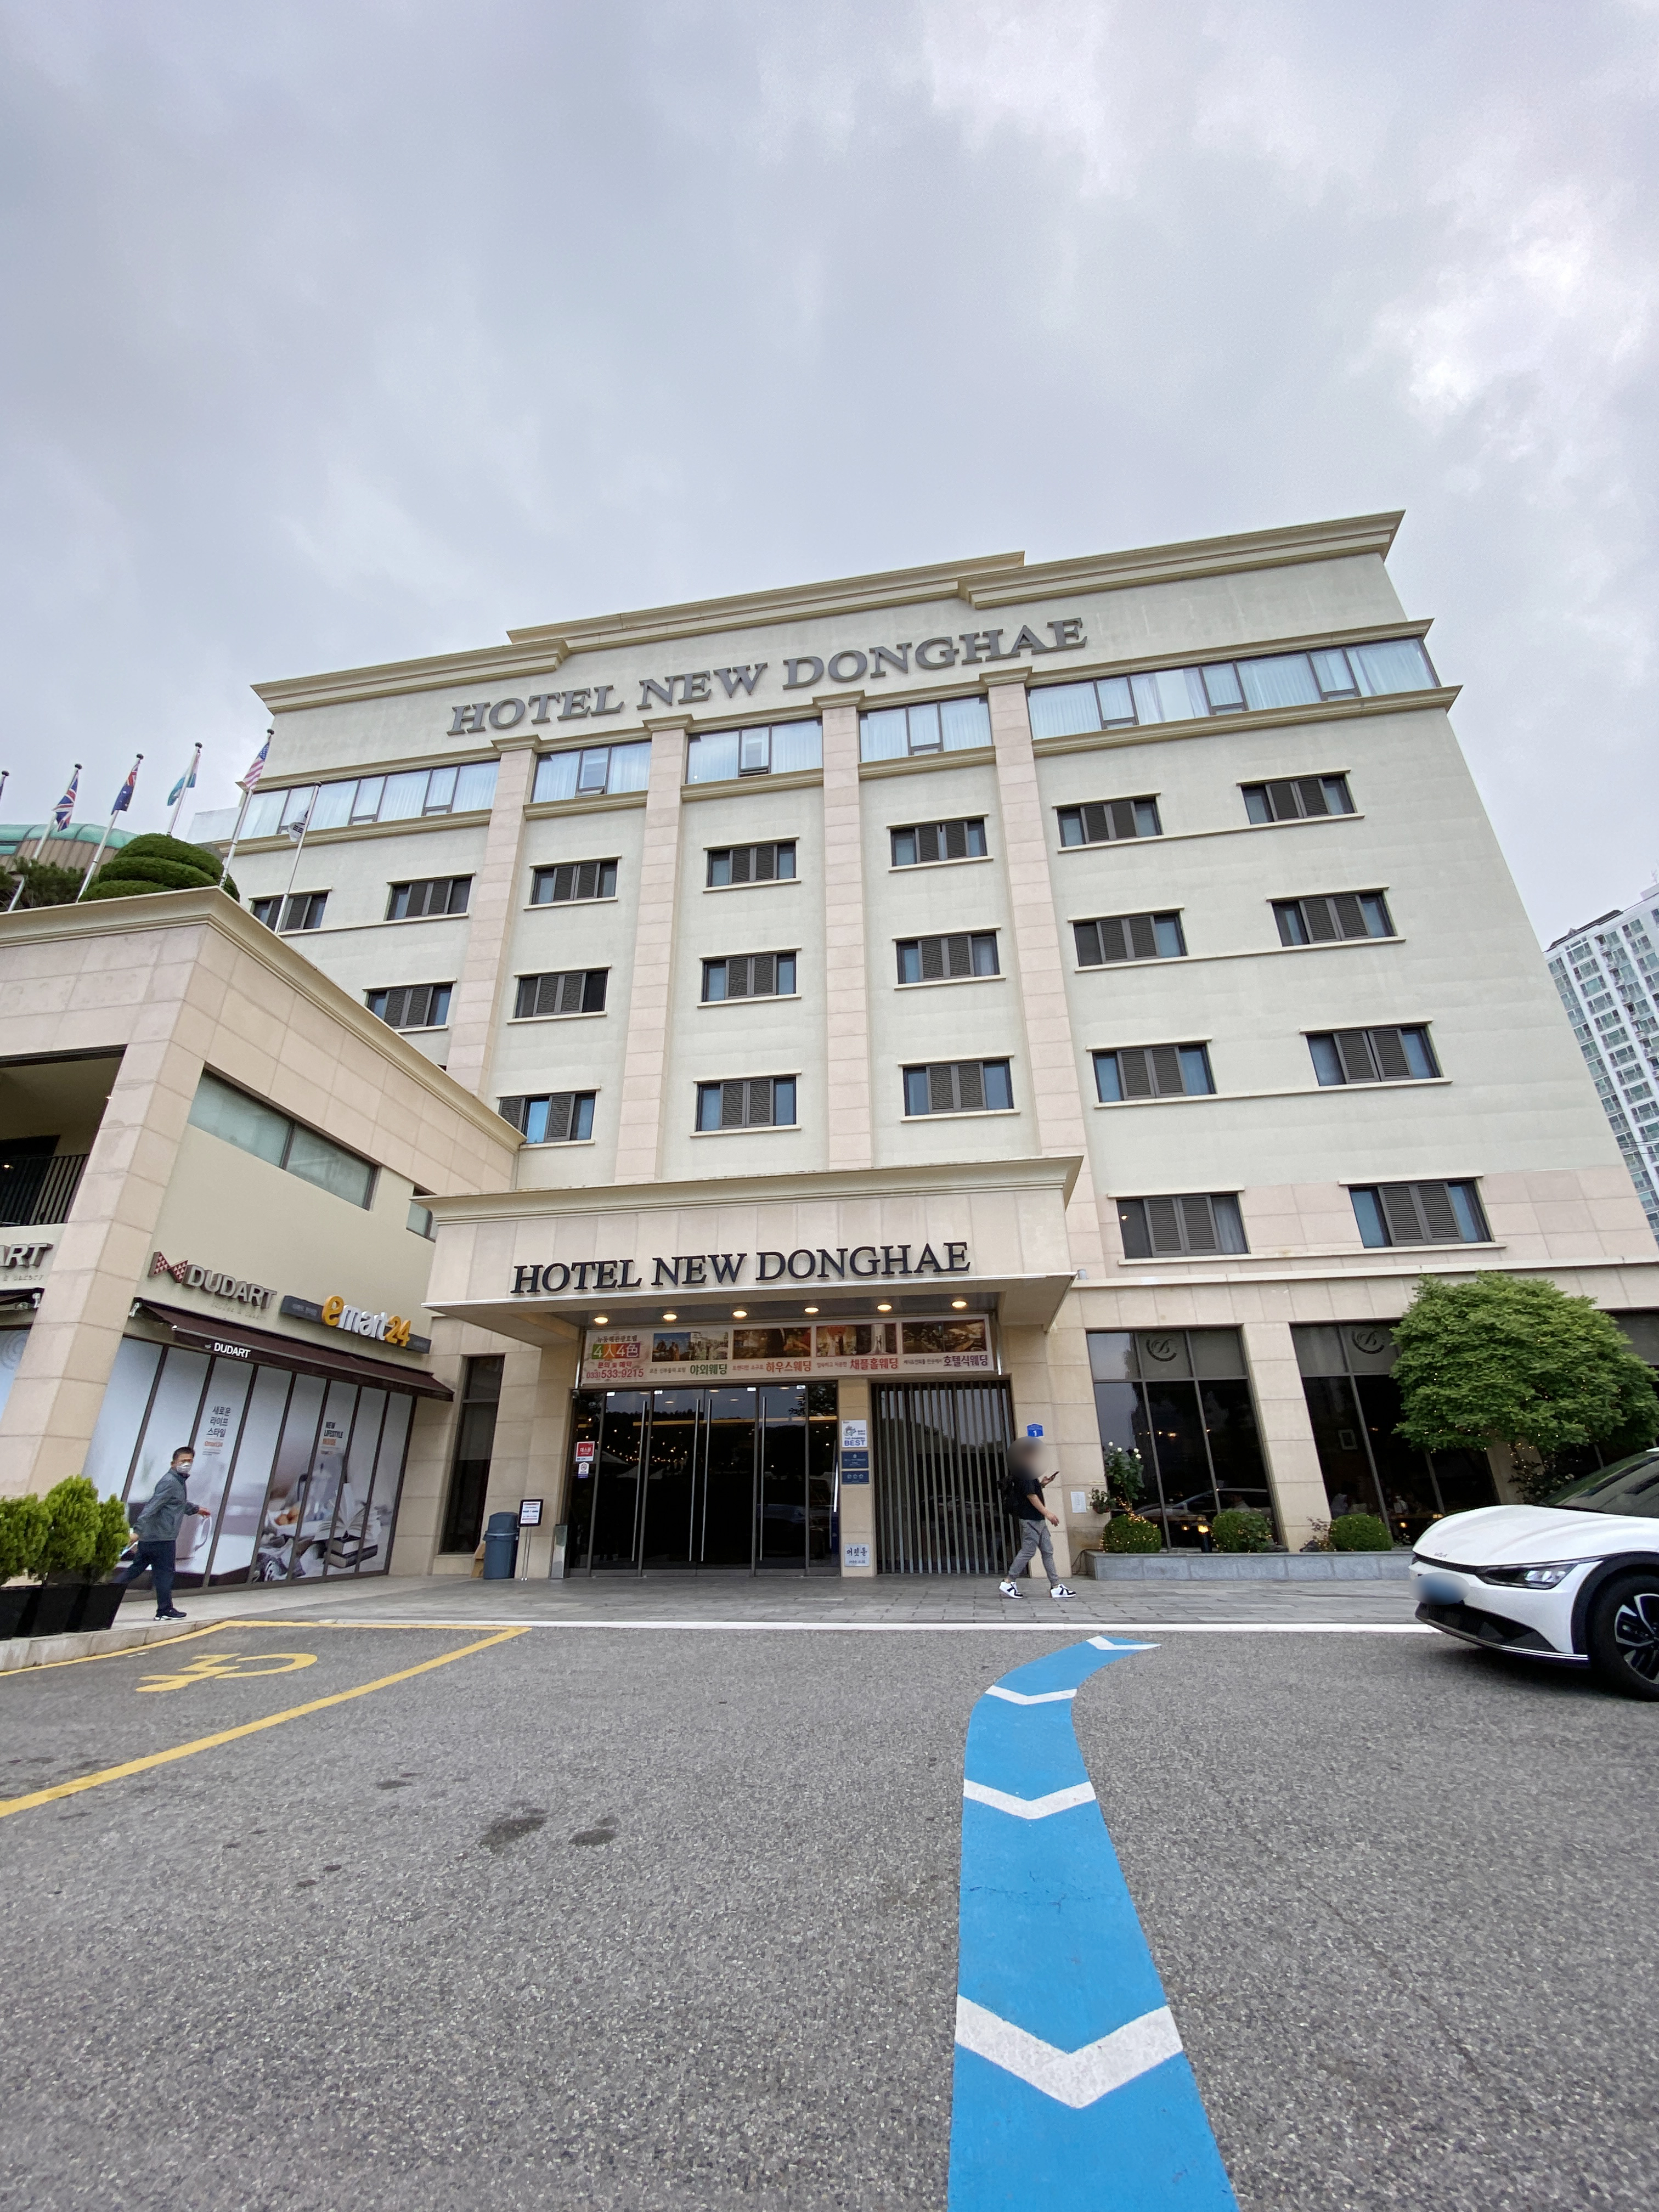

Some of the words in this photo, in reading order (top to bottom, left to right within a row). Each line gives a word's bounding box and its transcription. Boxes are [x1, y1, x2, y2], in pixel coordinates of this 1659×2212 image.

[447, 684, 624, 736] HOTEL
[637, 663, 768, 710] NEW
[783, 617, 1088, 690] DONGHAE
[510, 1260, 642, 1294] HOTEL
[652, 1253, 746, 1286] NEW
[757, 1242, 970, 1281] DONGHAE
[183, 1264, 278, 1309] DUDART
[322, 1295, 411, 1347] emart24
[214, 1342, 251, 1358] DUDART
[766, 1361, 811, 1373] 하우스웨딩
[850, 1358, 899, 1370] 채플홀웨딩
[943, 1355, 988, 1367] 호텔식웨딩
[690, 1363, 727, 1376] 야외웨딩
[212, 1406, 231, 1417] 새로운
[210, 1417, 228, 1426] 라이프
[206, 1427, 227, 1438] 스타일
[847, 1547, 867, 1556] 머릿돌
